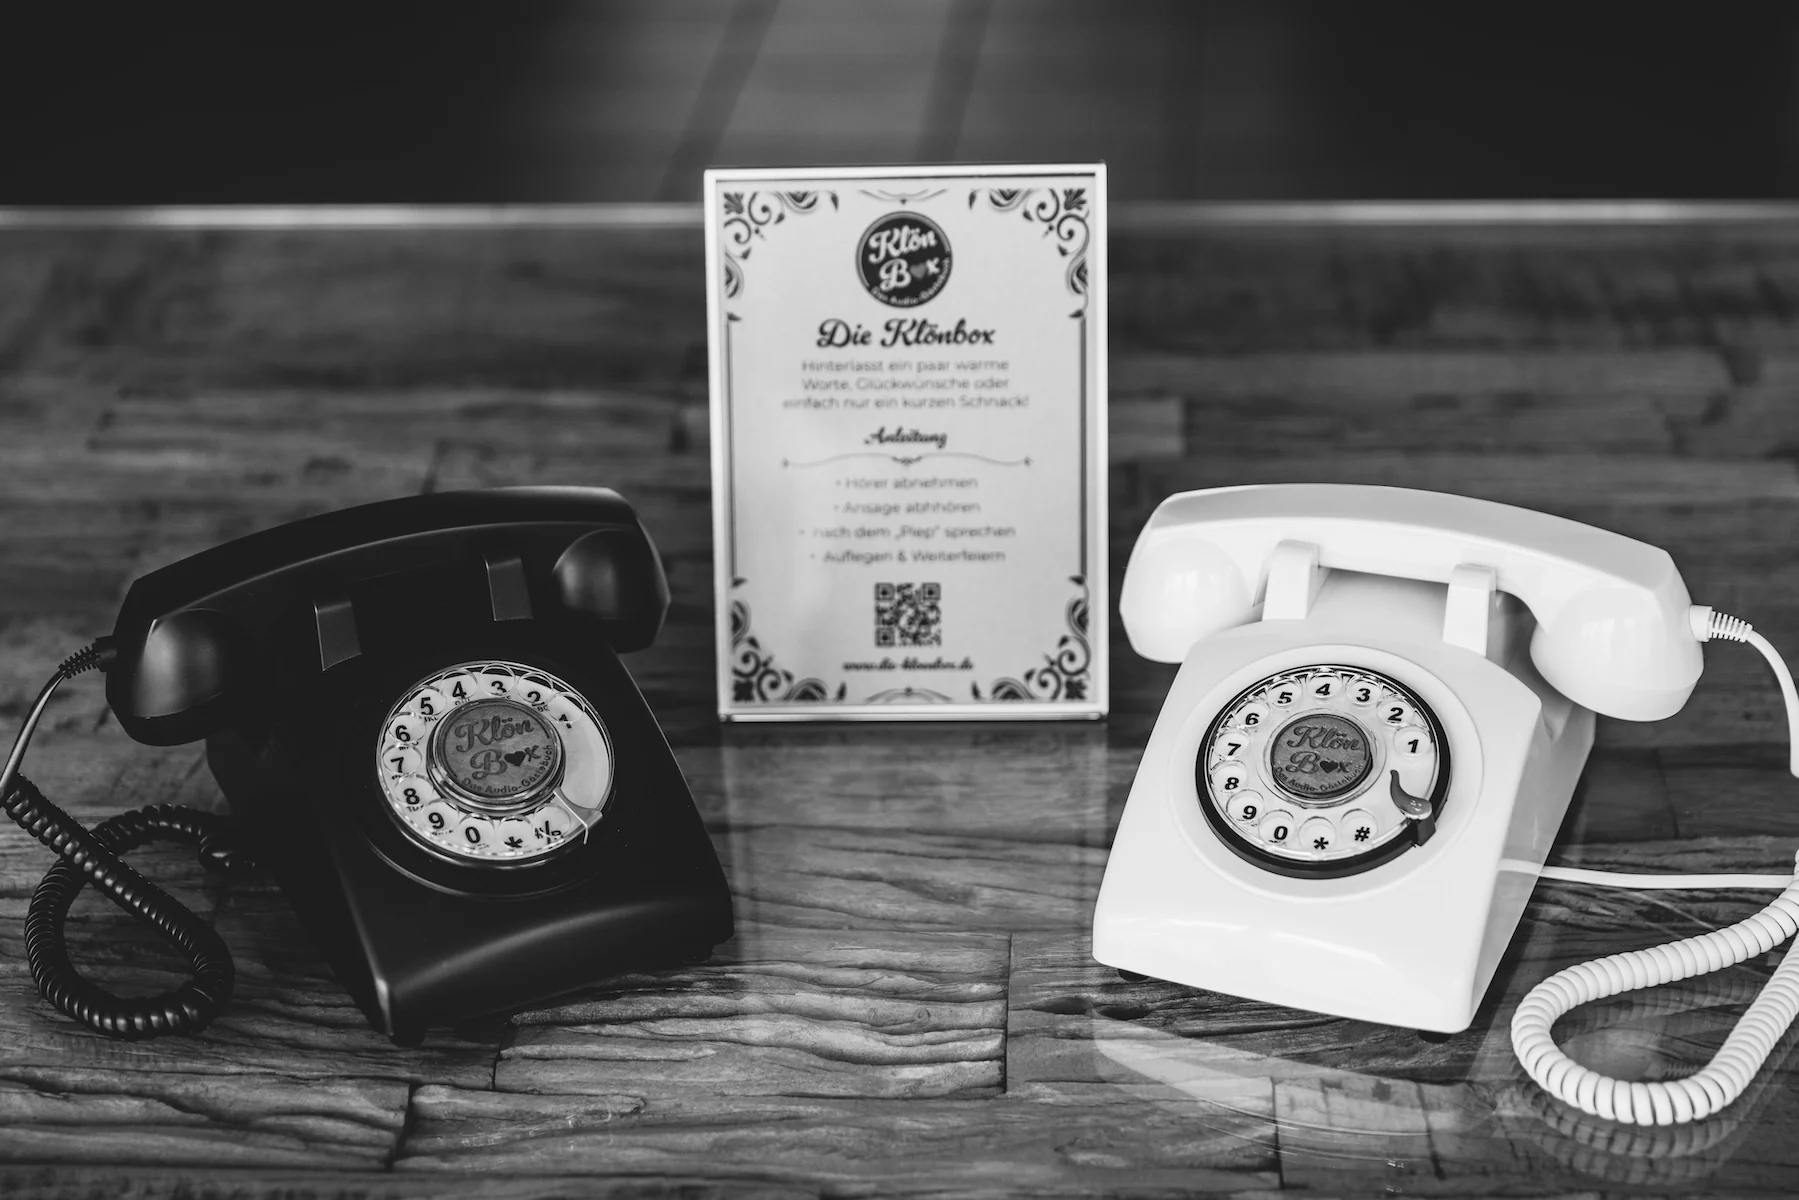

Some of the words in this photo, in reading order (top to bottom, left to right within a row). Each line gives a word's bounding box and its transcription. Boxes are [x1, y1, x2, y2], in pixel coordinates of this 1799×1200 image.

[868, 225, 937, 263] Klön
[816, 319, 872, 348] Die
[880, 319, 995, 348] Klönbox
[801, 360, 884, 372] Hinterlasst
[888, 360, 911, 372] ein
[916, 361, 951, 374] paar
[955, 360, 1009, 372] warme
[802, 378, 852, 390] Worte,
[855, 377, 970, 390] Glückwünsche
[973, 377, 1010, 390] oder
[782, 395, 840, 409] einfach
[843, 397, 869, 409] nur
[874, 396, 898, 408] ein
[902, 395, 956, 408] kurzen
[959, 394, 1029, 408] Schnack!
[864, 426, 947, 448] Anleitung
[846, 477, 888, 489] Hörer
[894, 477, 978, 489] abnehmen
[843, 501, 900, 515] Ansage
[812, 526, 851, 538] nach
[855, 526, 891, 538] dem
[945, 526, 1015, 540] sprechen
[824, 550, 893, 565] Auflegen
[898, 550, 907, 562] &
[912, 550, 1005, 562] Weiterfeiern
[452, 681, 466, 699] 4
[491, 680, 507, 695] 3
[1315, 683, 1330, 696] 4
[1356, 688, 1371, 702] 3
[420, 697, 434, 715] 5
[1278, 692, 1293, 705] 5
[1245, 713, 1260, 726] 6
[1387, 707, 1404, 723] 2
[395, 725, 411, 742] 6
[454, 715, 534, 753] Klön
[1287, 725, 1360, 751] Klön
[1227, 743, 1242, 756] 7
[1407, 739, 1419, 753] 1
[390, 756, 404, 773] 7
[1225, 777, 1239, 790] 8
[404, 788, 420, 805] 8
[1243, 805, 1257, 820] 9
[428, 812, 445, 829] 9
[465, 826, 481, 843] 0
[1274, 826, 1288, 840] 0
